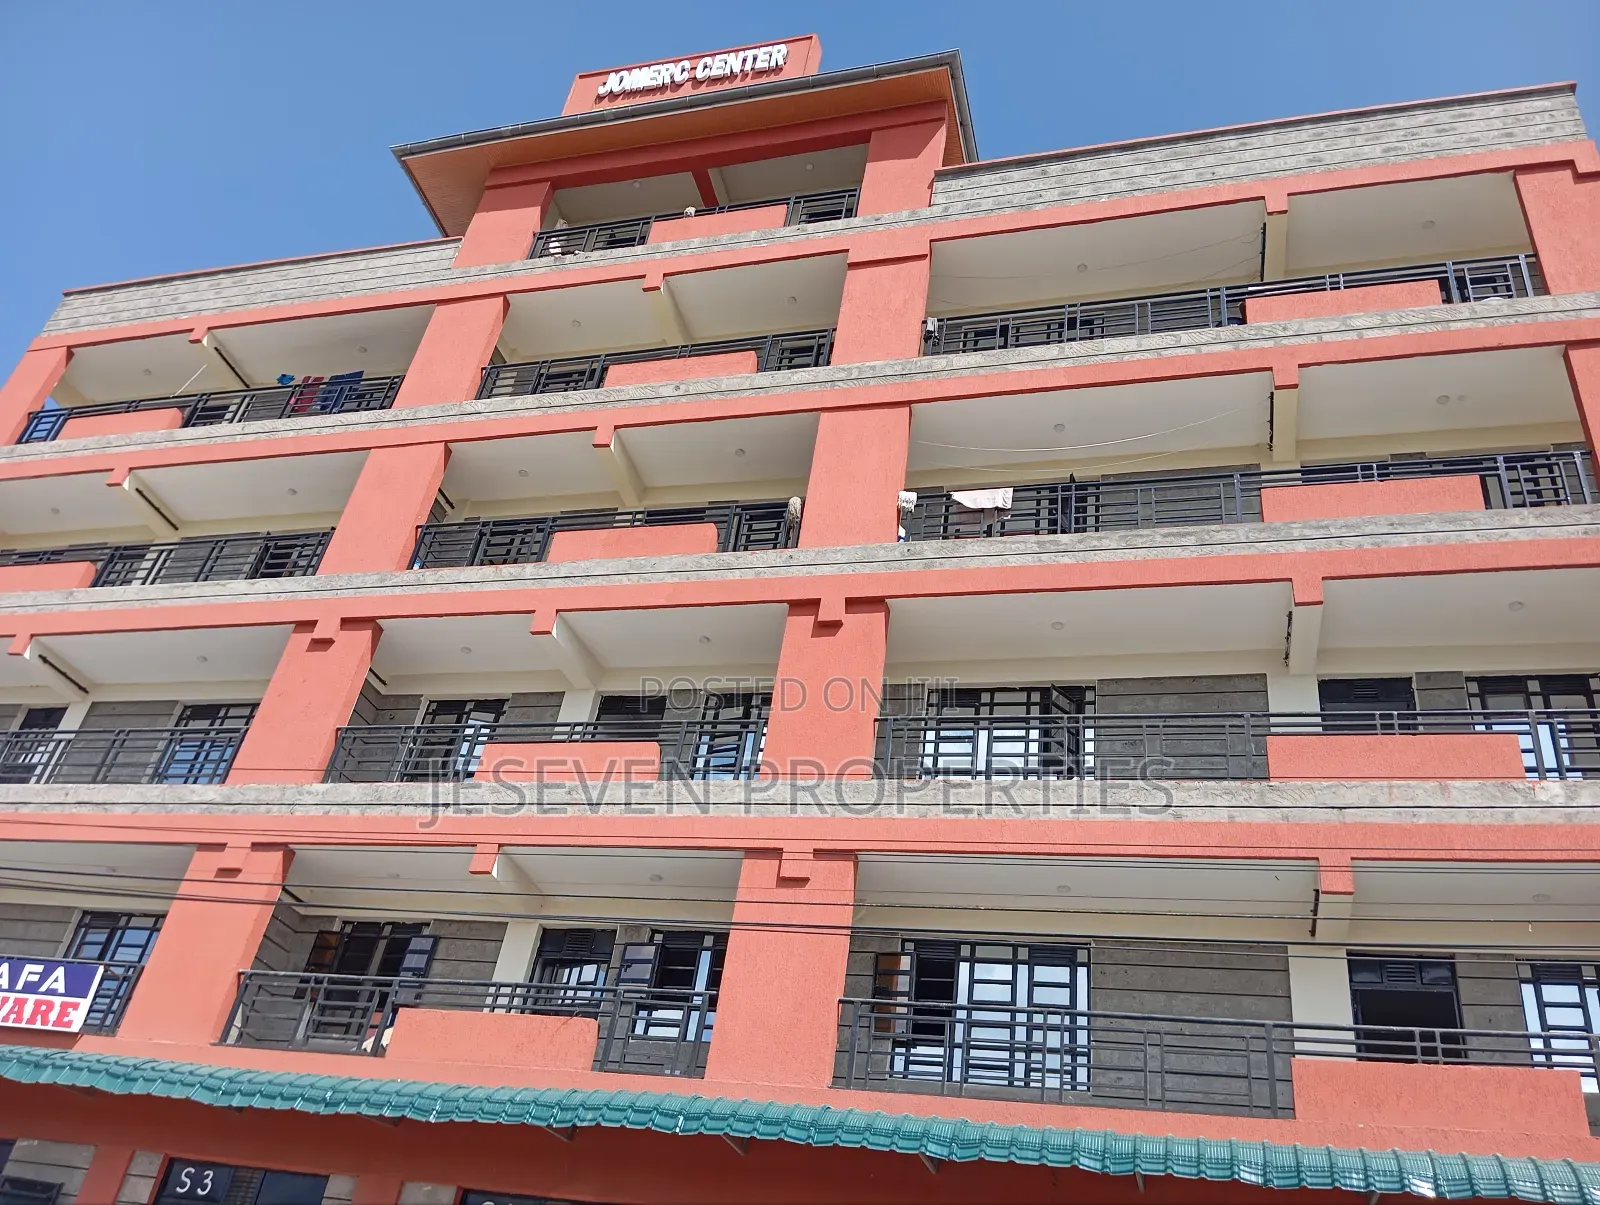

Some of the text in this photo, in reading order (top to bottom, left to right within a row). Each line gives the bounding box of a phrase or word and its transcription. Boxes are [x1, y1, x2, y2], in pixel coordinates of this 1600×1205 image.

[597, 43, 788, 96] JOMERC CENTER
[0, 996, 80, 1029] ARE
